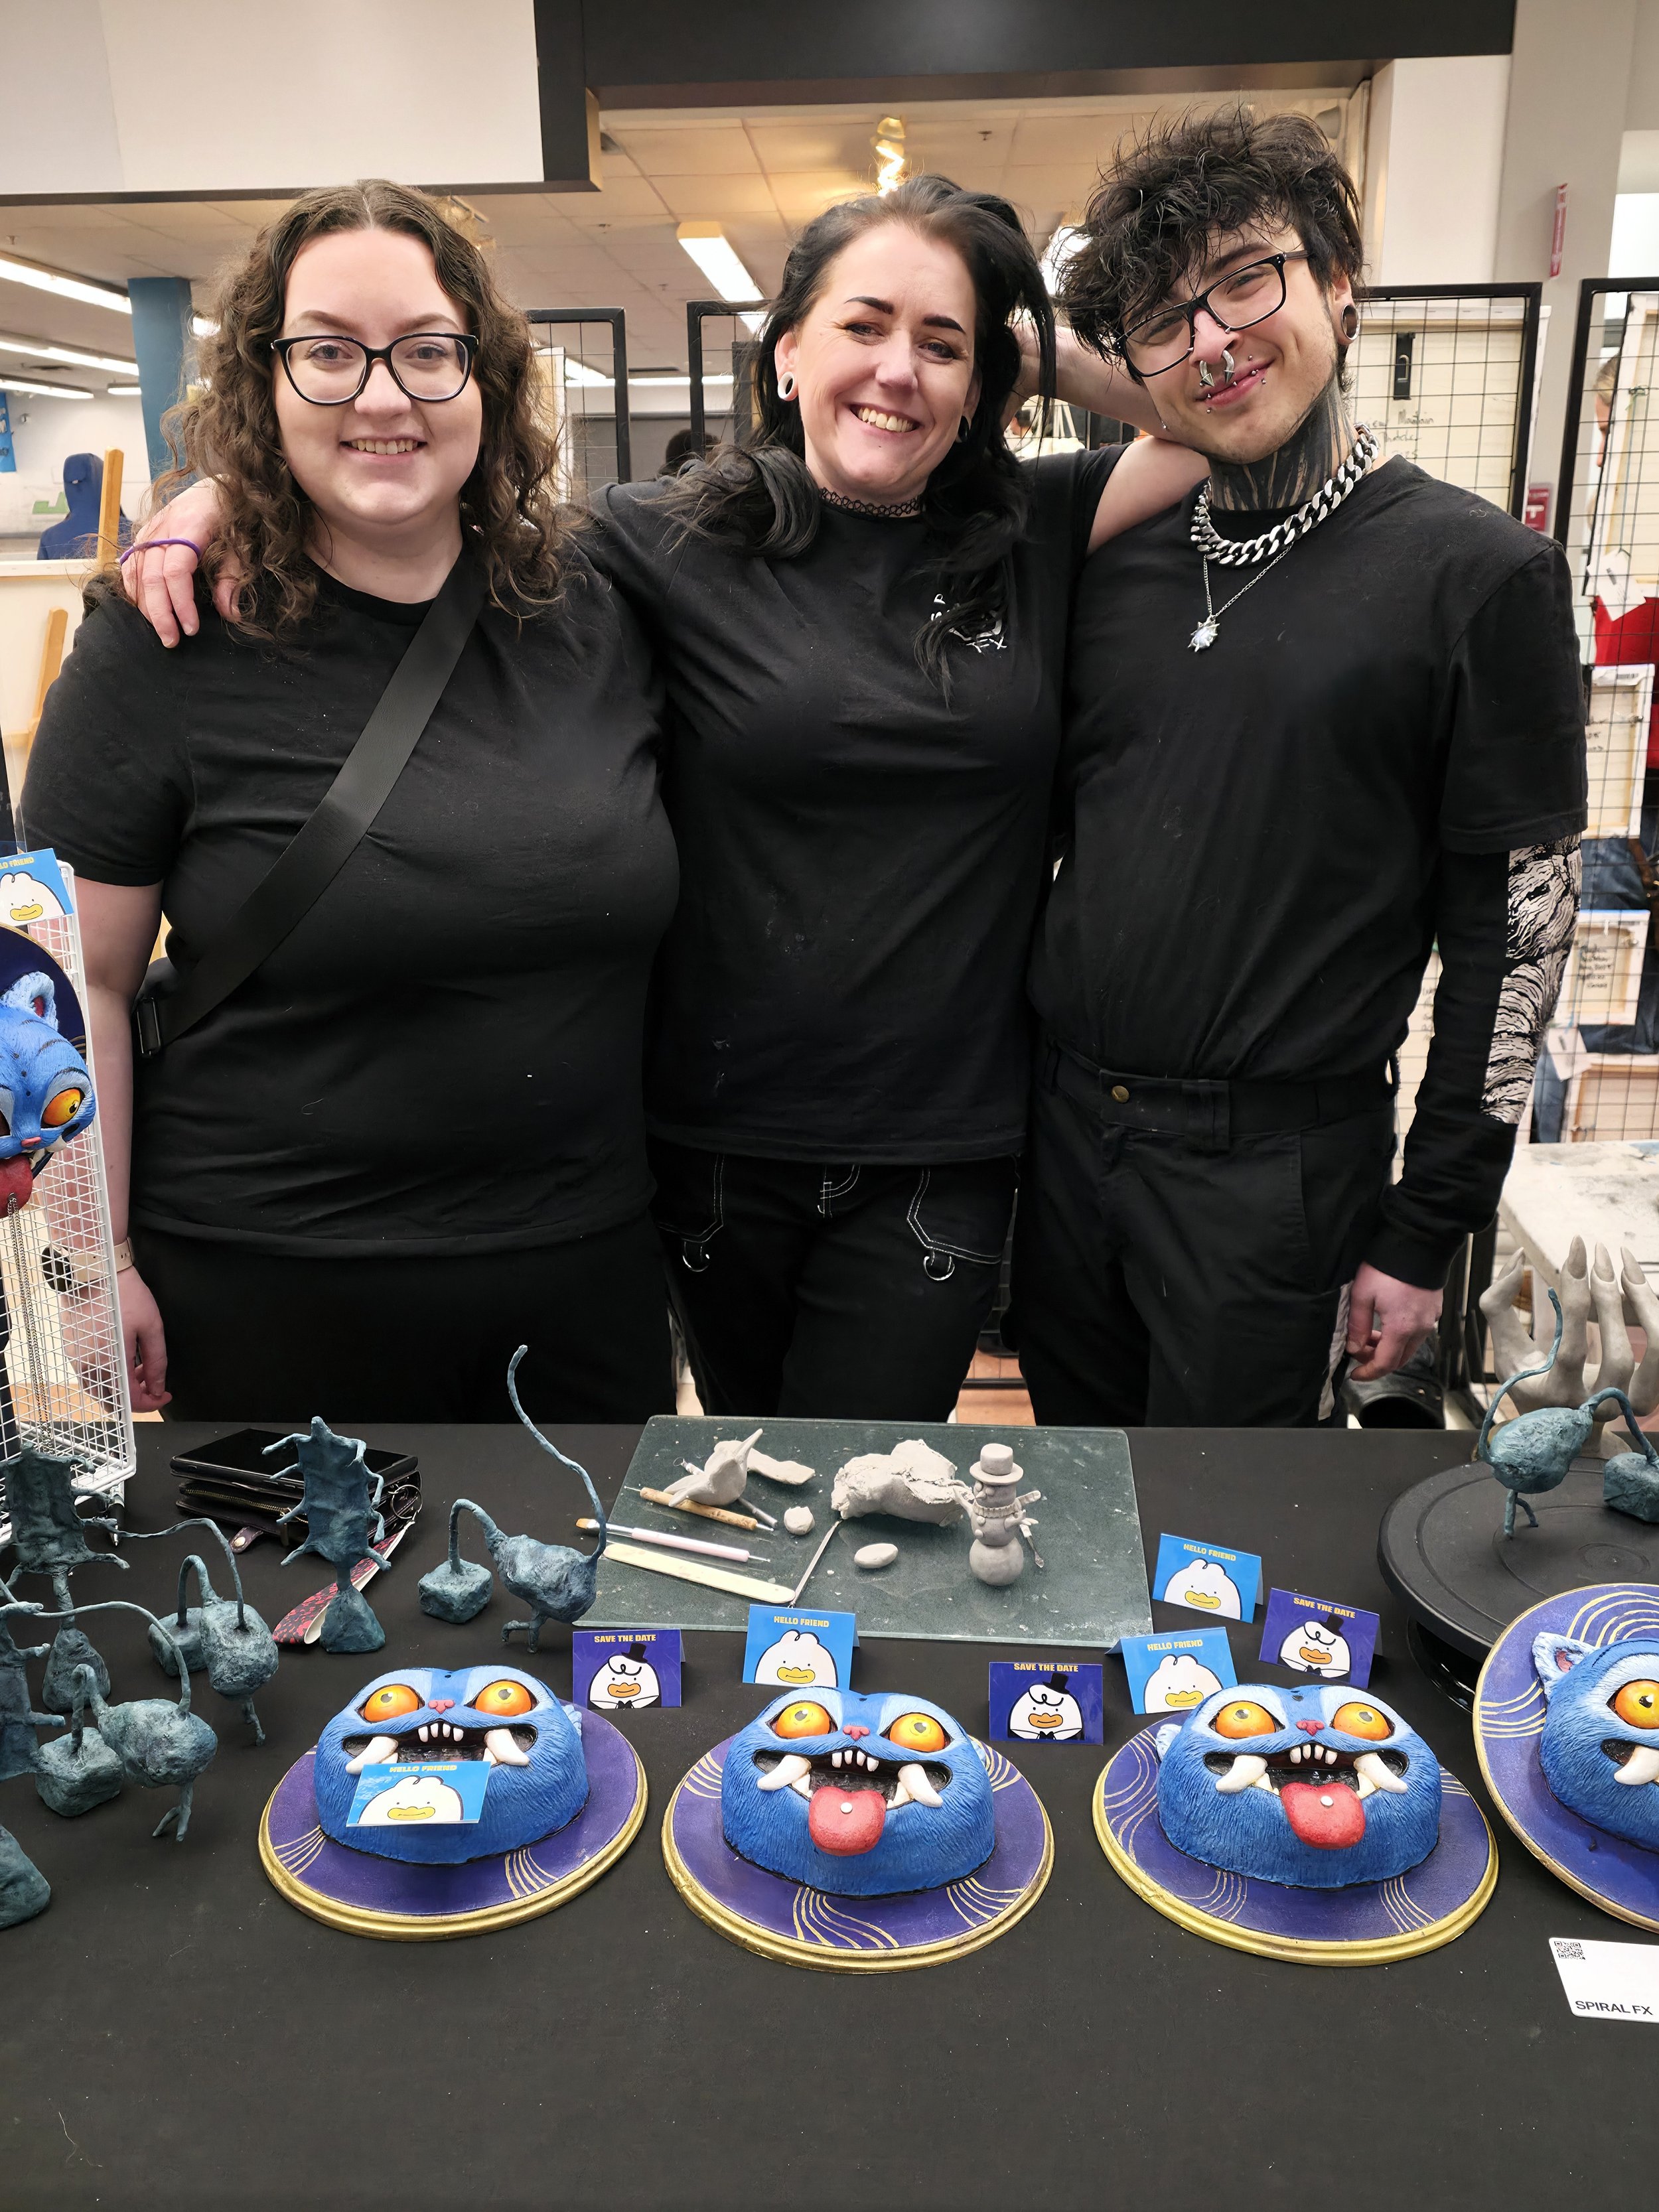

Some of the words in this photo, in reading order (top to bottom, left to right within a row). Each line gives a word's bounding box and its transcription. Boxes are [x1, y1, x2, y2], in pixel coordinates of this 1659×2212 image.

[9, 857, 35, 866] FRIEND
[1184, 1544, 1206, 1555] HELLO
[1208, 1549, 1236, 1561] FRIEND
[1293, 1597, 1315, 1609] SAVE
[1317, 1602, 1333, 1614] THE
[1334, 1606, 1356, 1619] DATE
[774, 1616, 798, 1625] HELLO
[800, 1618, 830, 1627] FRIEND
[1147, 1641, 1172, 1651] HELLO
[1174, 1639, 1203, 1648] FRIEND
[1575, 2000, 1630, 2014] SPIRAL
[1632, 2005, 1653, 2016] FX
